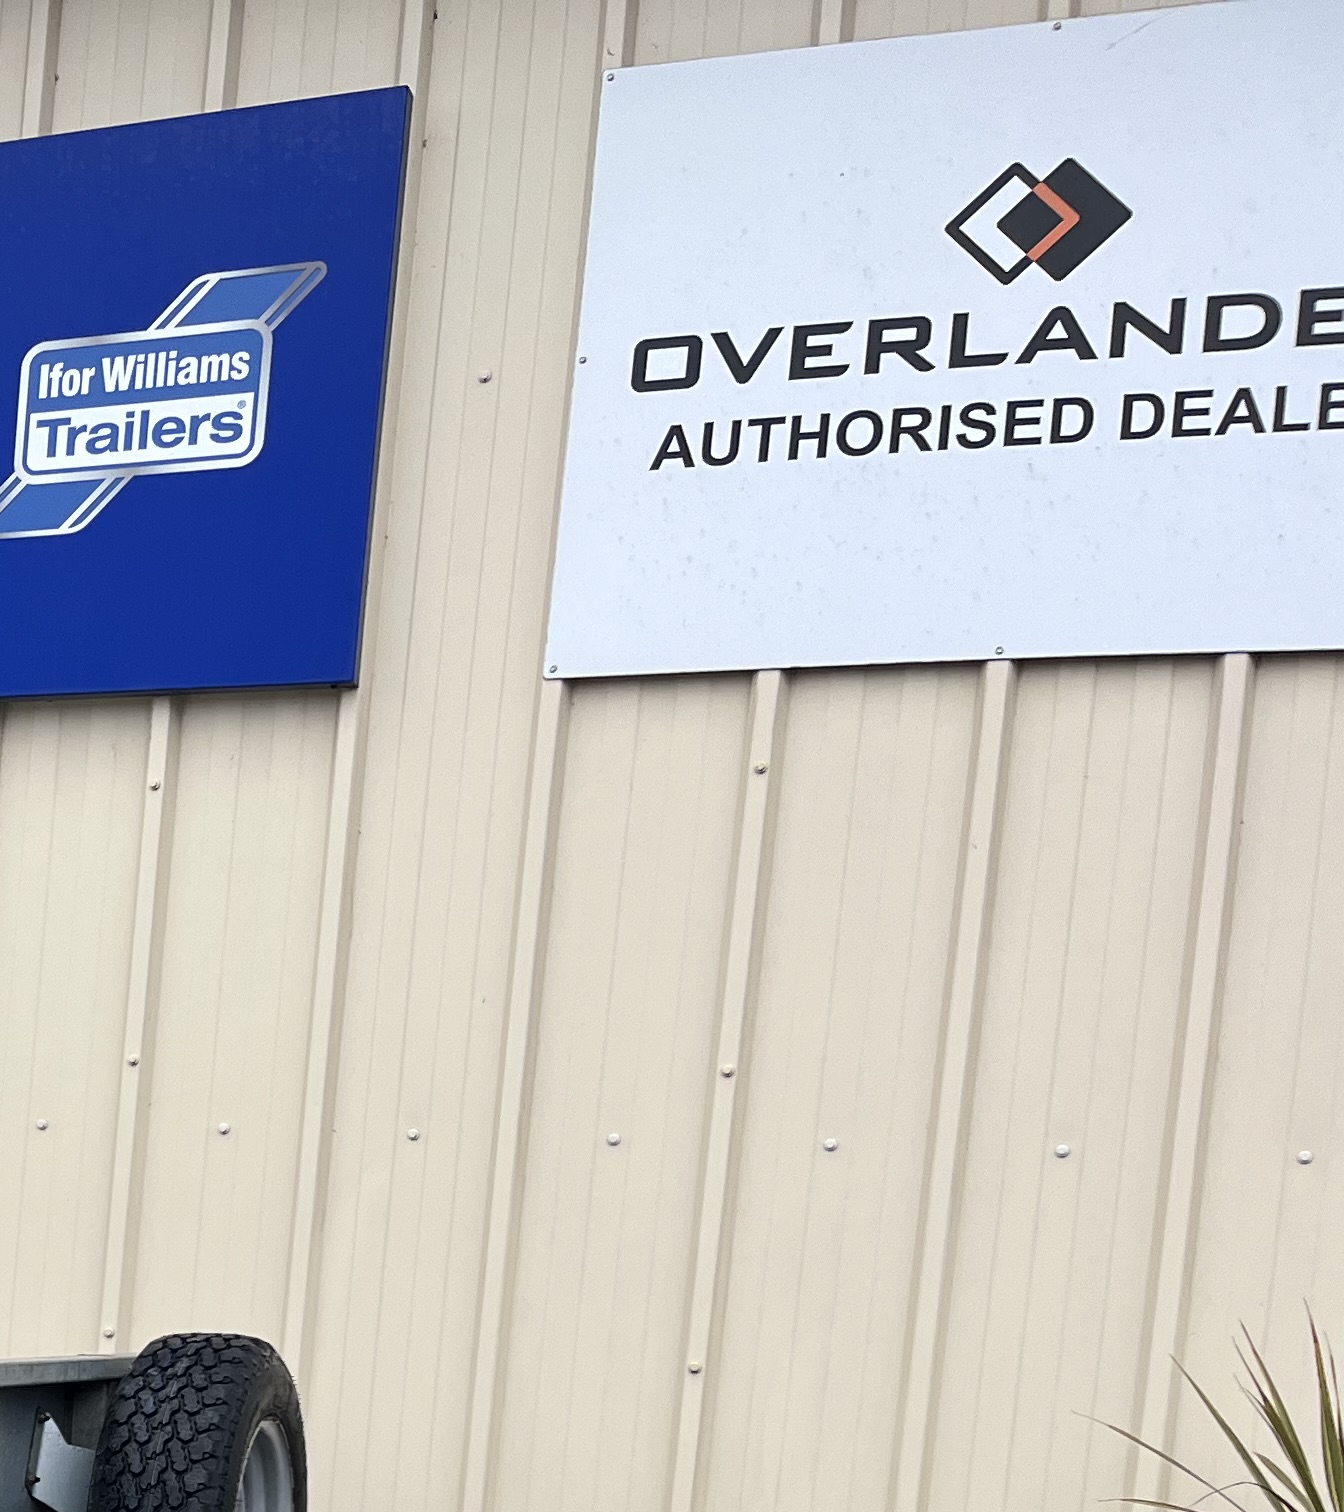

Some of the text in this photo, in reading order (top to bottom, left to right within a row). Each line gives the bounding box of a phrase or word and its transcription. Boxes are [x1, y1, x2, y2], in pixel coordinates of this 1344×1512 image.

[630, 286, 1344, 393] OVERLANDE
[37, 350, 251, 400] Ifor Williams
[36, 409, 245, 458] Trailers
[649, 382, 1344, 471] AUTHORISED DEALE
